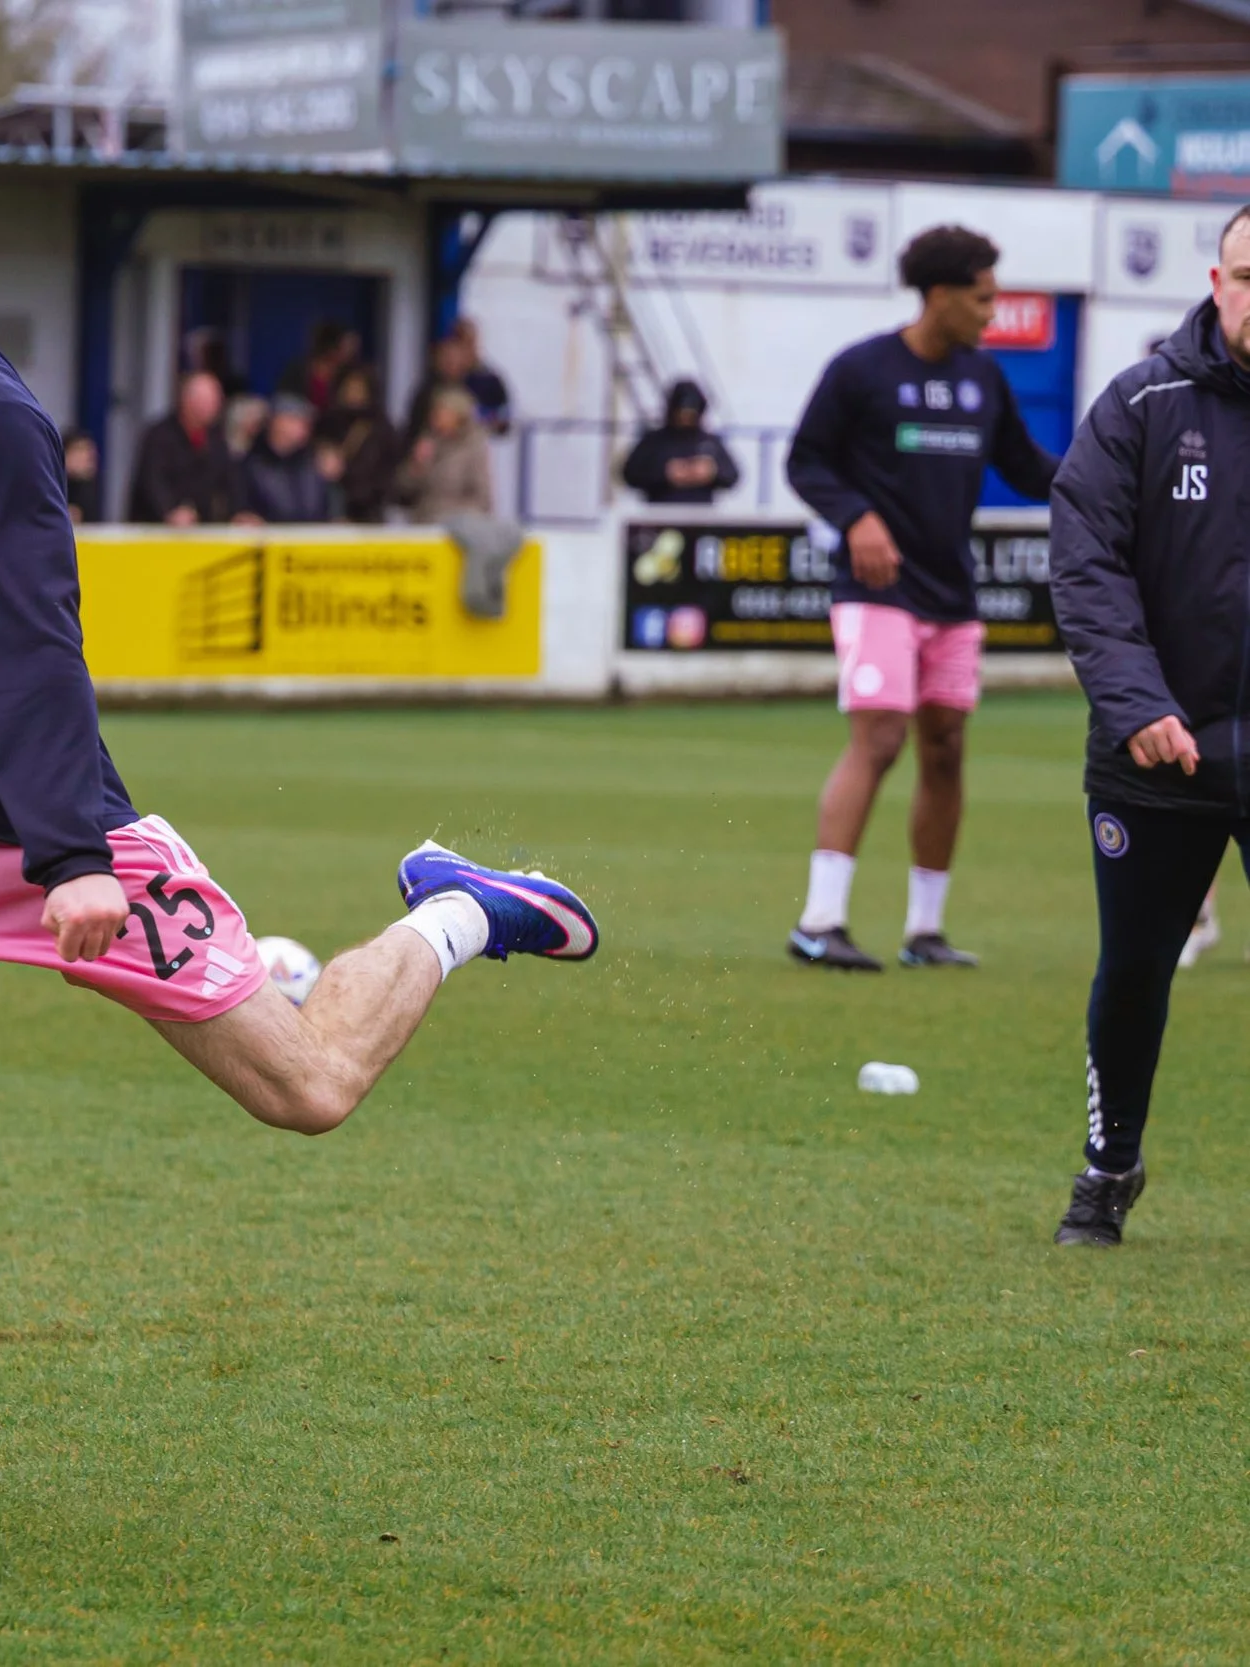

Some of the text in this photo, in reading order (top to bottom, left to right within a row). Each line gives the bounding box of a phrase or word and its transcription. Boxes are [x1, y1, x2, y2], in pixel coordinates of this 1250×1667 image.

[411, 52, 777, 124] SKYSCAPE
[1172, 464, 1208, 501] JS
[277, 583, 431, 632] Blinds
[116, 873, 215, 981] 25
